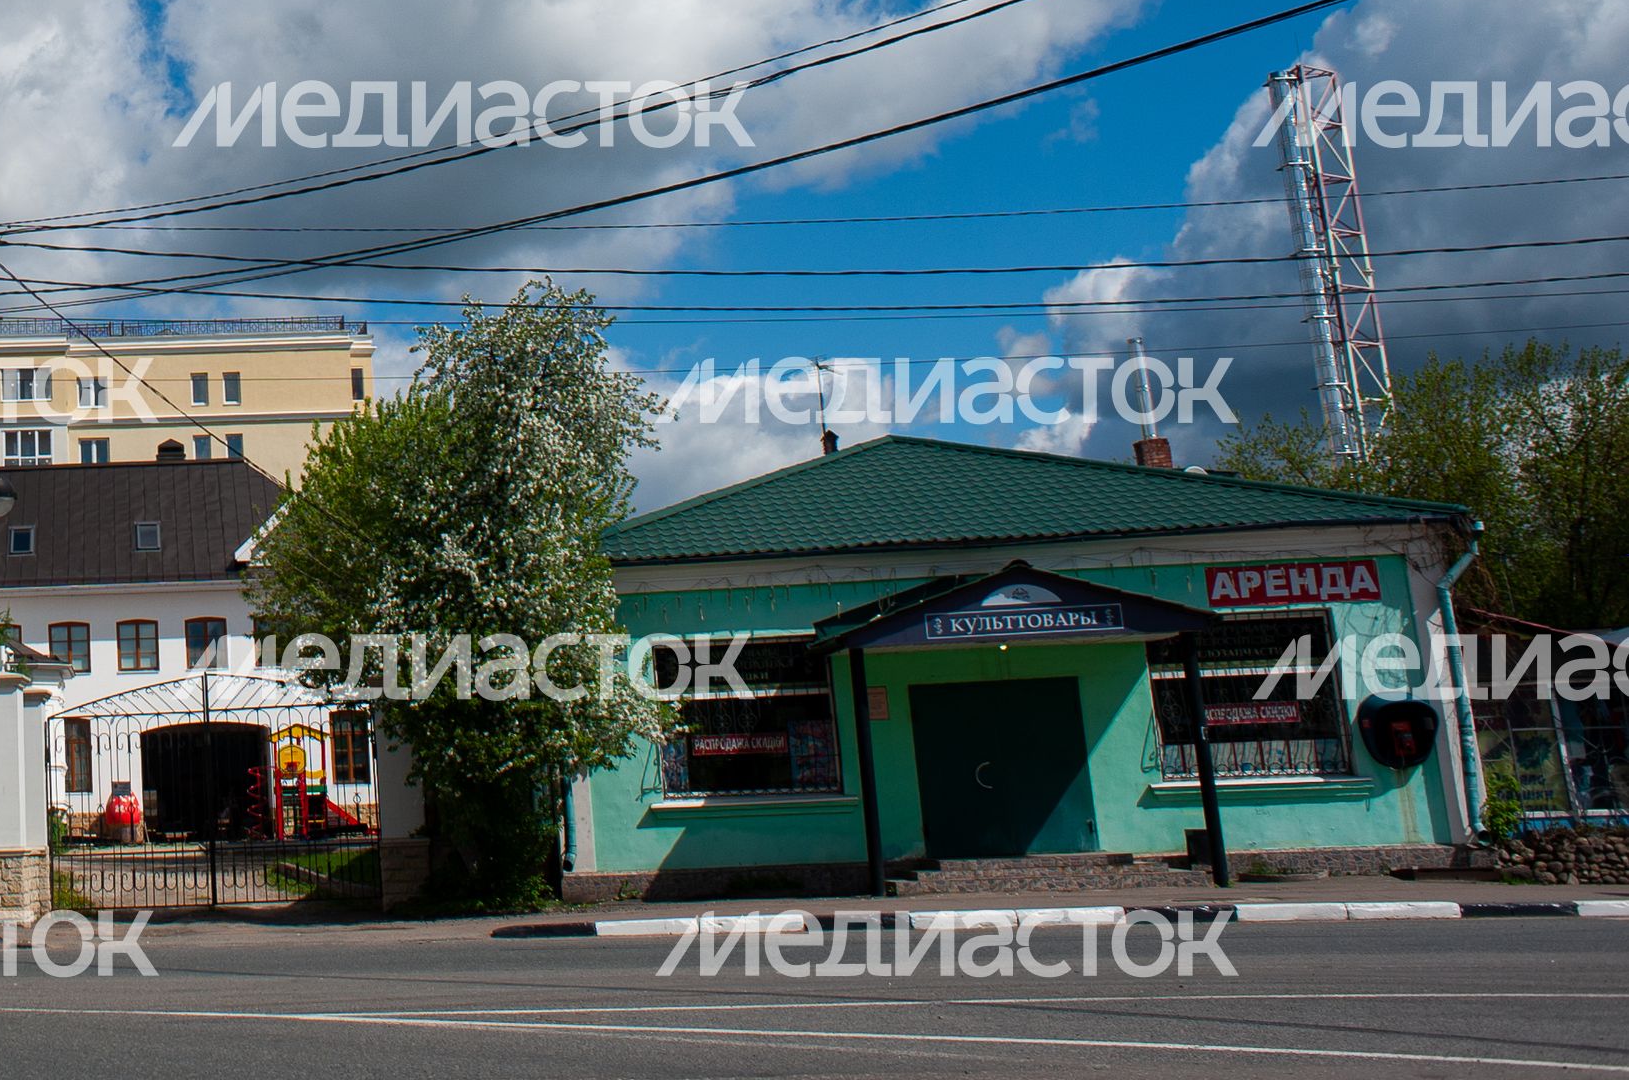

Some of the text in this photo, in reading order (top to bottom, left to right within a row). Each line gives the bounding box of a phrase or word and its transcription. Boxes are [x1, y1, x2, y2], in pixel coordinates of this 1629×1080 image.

[1211, 565, 1380, 602] АРЕНДА
[949, 610, 1099, 635] КУЛЬТТОВАРЫ
[1204, 706, 1259, 722] АСПРОДАЖА
[694, 736, 751, 751] РАСПРОДАЖА
